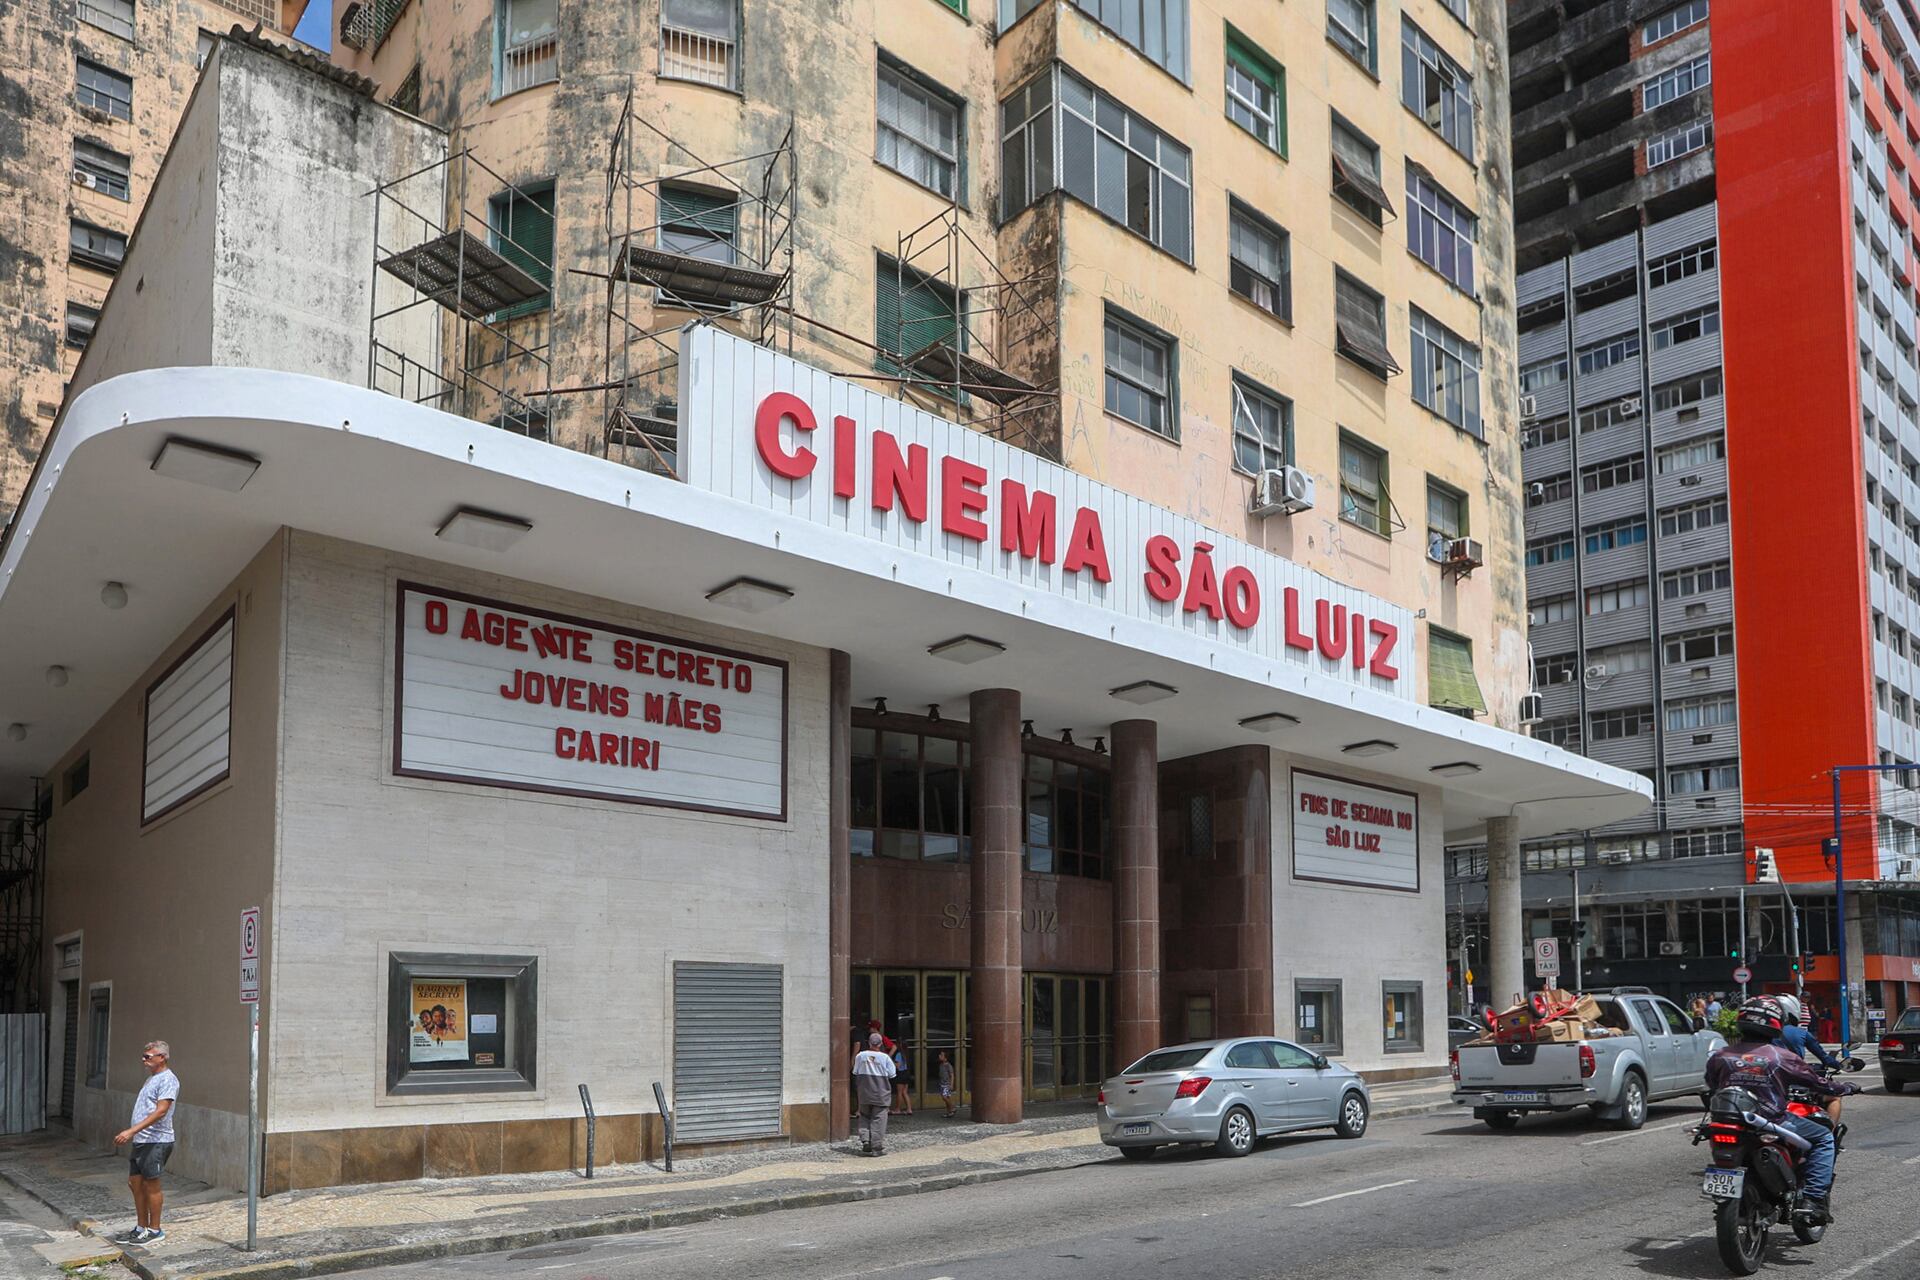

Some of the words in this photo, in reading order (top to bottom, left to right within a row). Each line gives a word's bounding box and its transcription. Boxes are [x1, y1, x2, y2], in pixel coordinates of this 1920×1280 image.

[755, 391, 1112, 583] CINEMA
[1144, 533, 1261, 630] SÃO
[1283, 586, 1400, 681] LUIZ
[425, 600, 448, 635] O
[460, 607, 593, 664] AGENTE
[613, 639, 752, 693] SECRETO
[500, 669, 629, 717] JOVENS
[644, 692, 722, 733] MÃES
[555, 726, 660, 771] CARIRI
[1300, 792, 1328, 816] FINS
[1331, 798, 1348, 820] DE
[1351, 803, 1395, 828] SEMANA
[1397, 811, 1413, 831] NO
[1326, 824, 1351, 849] SÃO
[1354, 831, 1381, 853] LUIZ
[247, 925, 253, 947] E
[1543, 945, 1549, 954] E
[242, 967, 257, 982] TAXI
[1539, 962, 1556, 970] TAXI
[1712, 1174, 1734, 1185] SOR
